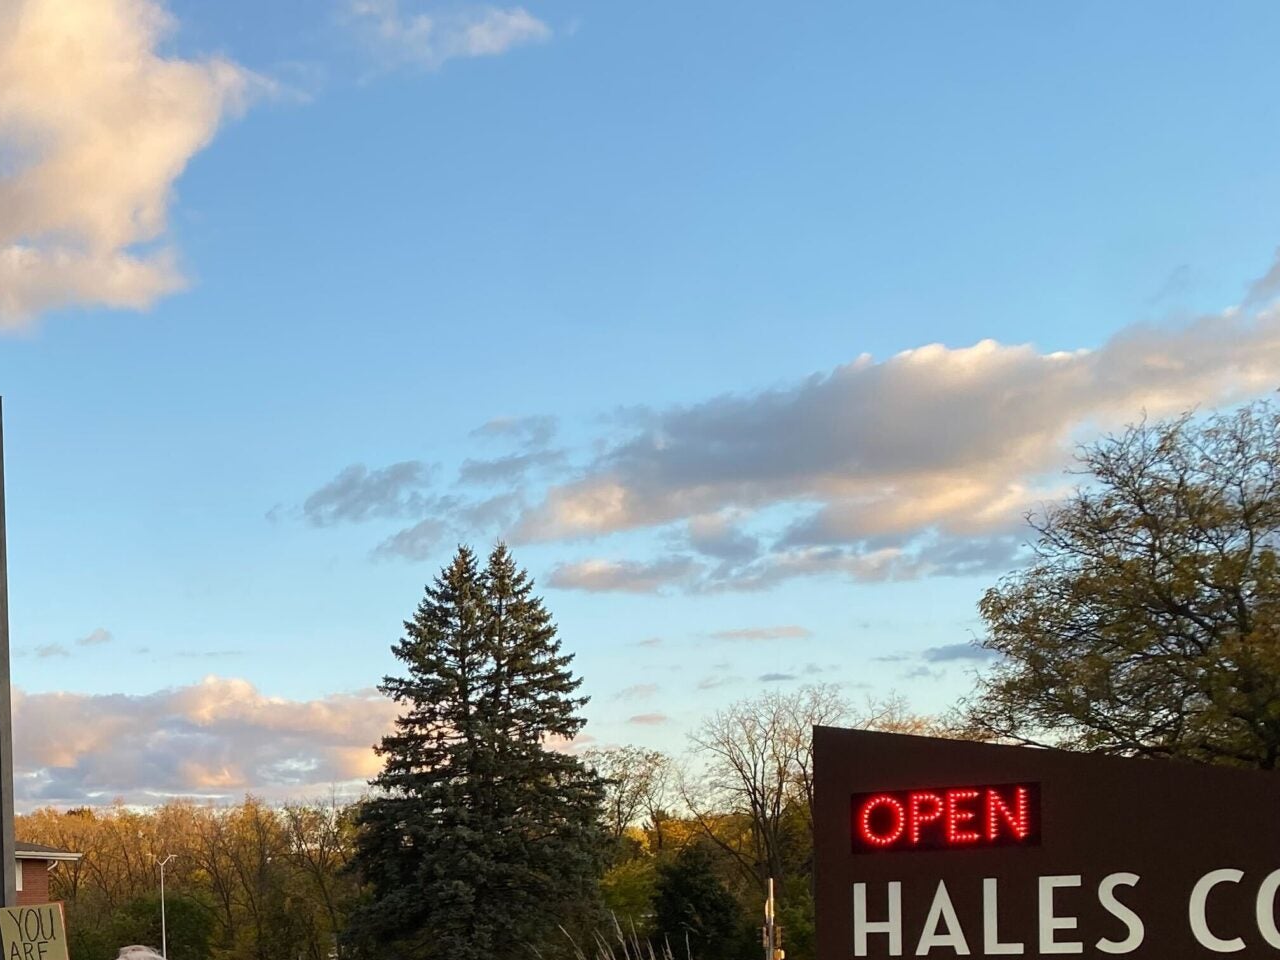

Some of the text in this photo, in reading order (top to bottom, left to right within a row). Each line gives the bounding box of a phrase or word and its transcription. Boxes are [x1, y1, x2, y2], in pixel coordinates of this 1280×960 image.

[861, 786, 1030, 845] OPEN
[8, 908, 56, 942] YOU
[853, 872, 1145, 957] HALES
